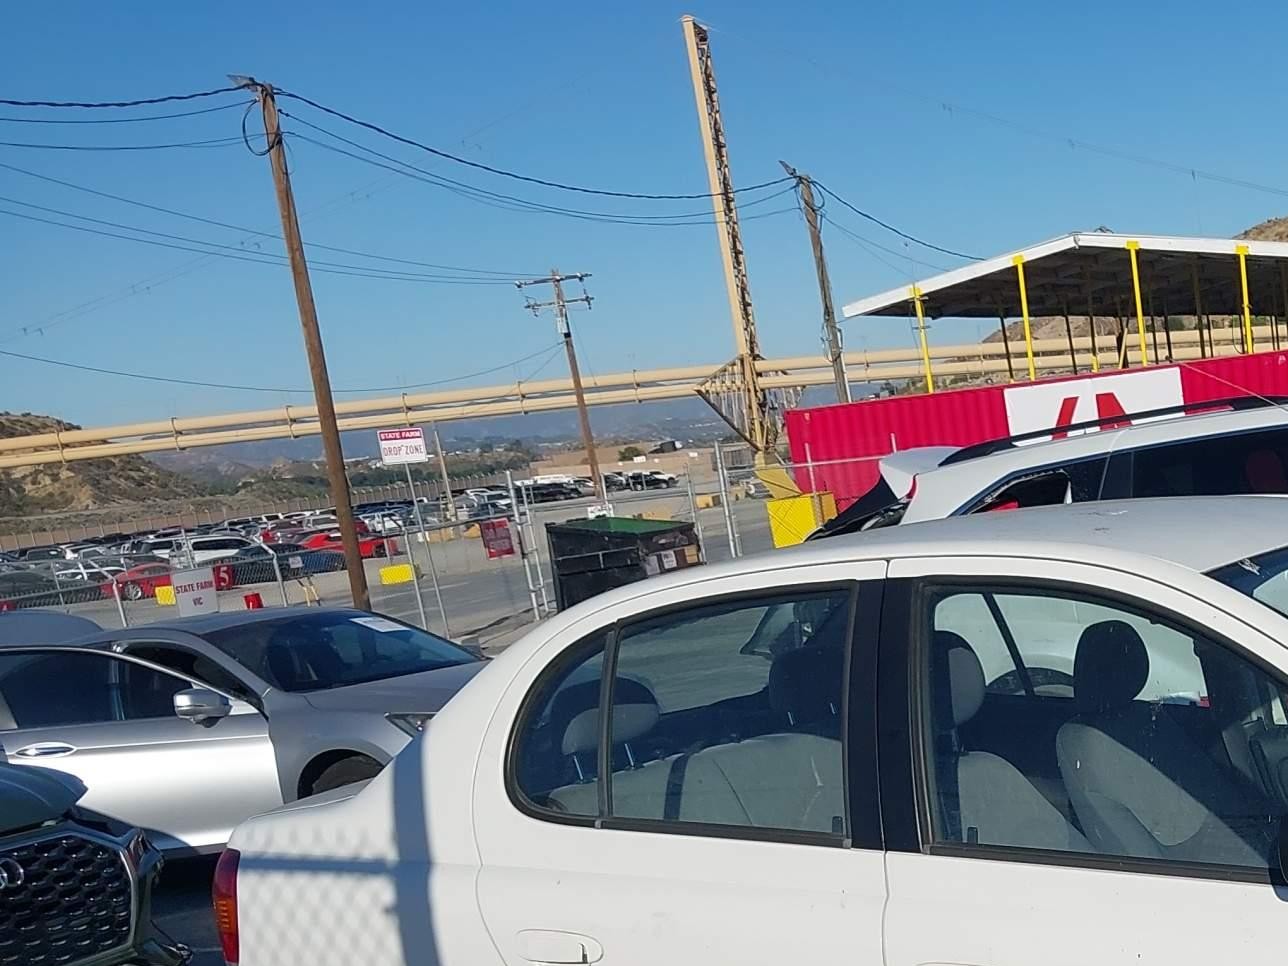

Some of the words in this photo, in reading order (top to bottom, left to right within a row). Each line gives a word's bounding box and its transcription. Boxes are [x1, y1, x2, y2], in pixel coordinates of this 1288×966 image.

[380, 432, 400, 440] STATE
[383, 446, 402, 456] DROP
[404, 444, 424, 455] ZONE
[219, 566, 229, 586] 5
[175, 583, 195, 594] STATE
[196, 580, 213, 591] FARM
